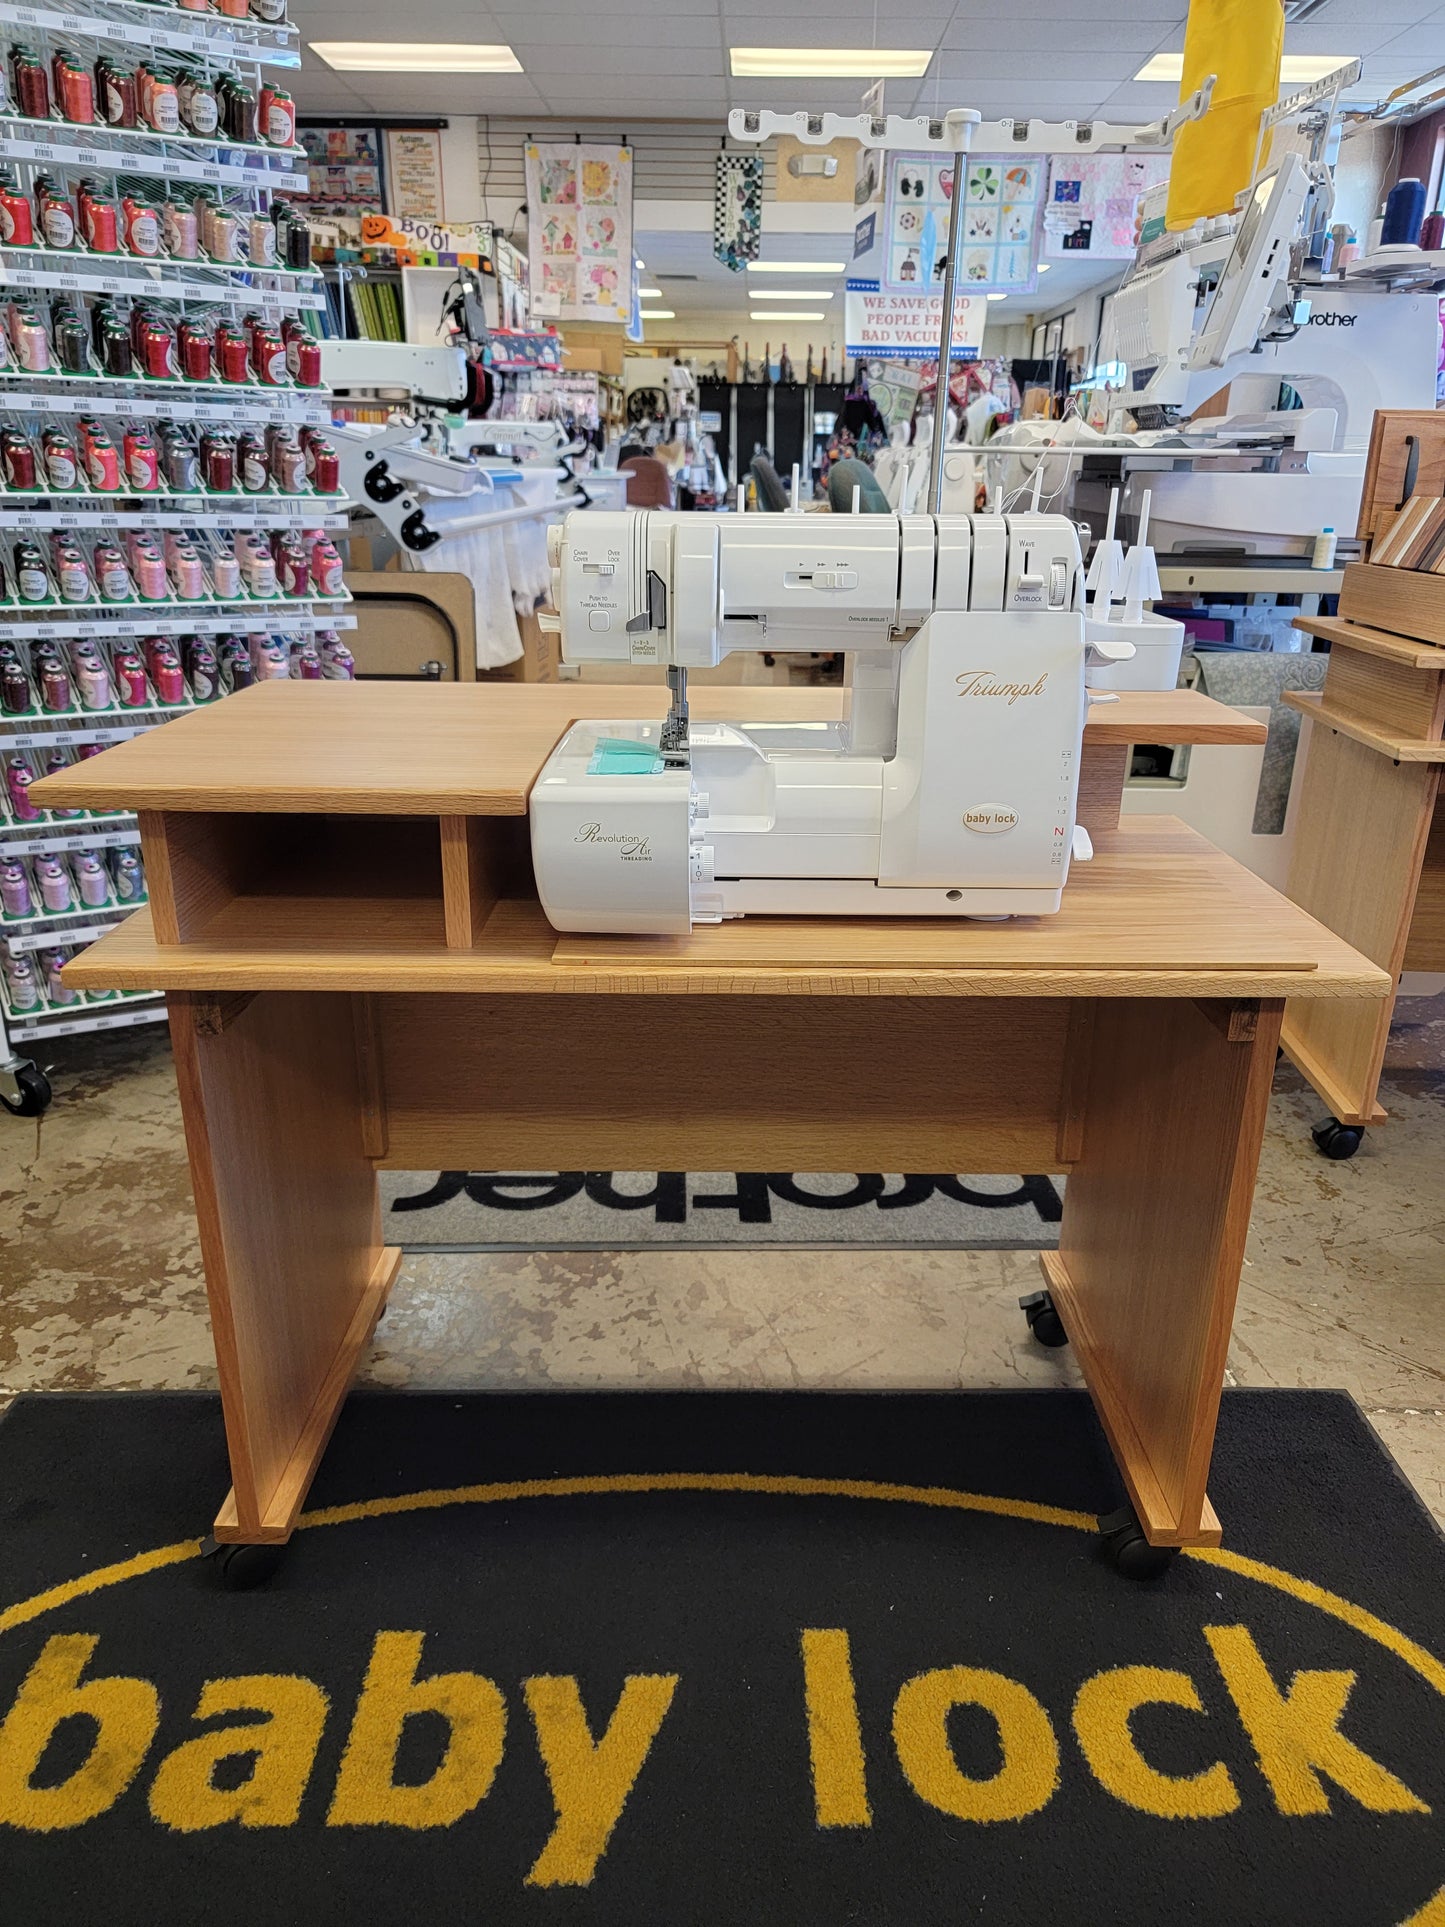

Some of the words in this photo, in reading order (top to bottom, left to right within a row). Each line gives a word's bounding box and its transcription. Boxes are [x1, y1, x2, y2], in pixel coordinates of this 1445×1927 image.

[863, 297, 886, 309] WE
[890, 297, 925, 309] SAVE
[930, 298, 970, 309] GD
[867, 314, 919, 326] PEOPLE
[925, 315, 964, 326] FRM
[1308, 312, 1358, 327] rother
[861, 330, 889, 341] BAD
[956, 671, 1048, 705] Triumph
[966, 813, 991, 825] baby
[994, 813, 1016, 824] lock
[574, 822, 639, 843] Revolution
[1054, 827, 1065, 836] N
[620, 836, 652, 855] Air
[0, 1632, 681, 1888] baby
[801, 1624, 1433, 1830] lock
